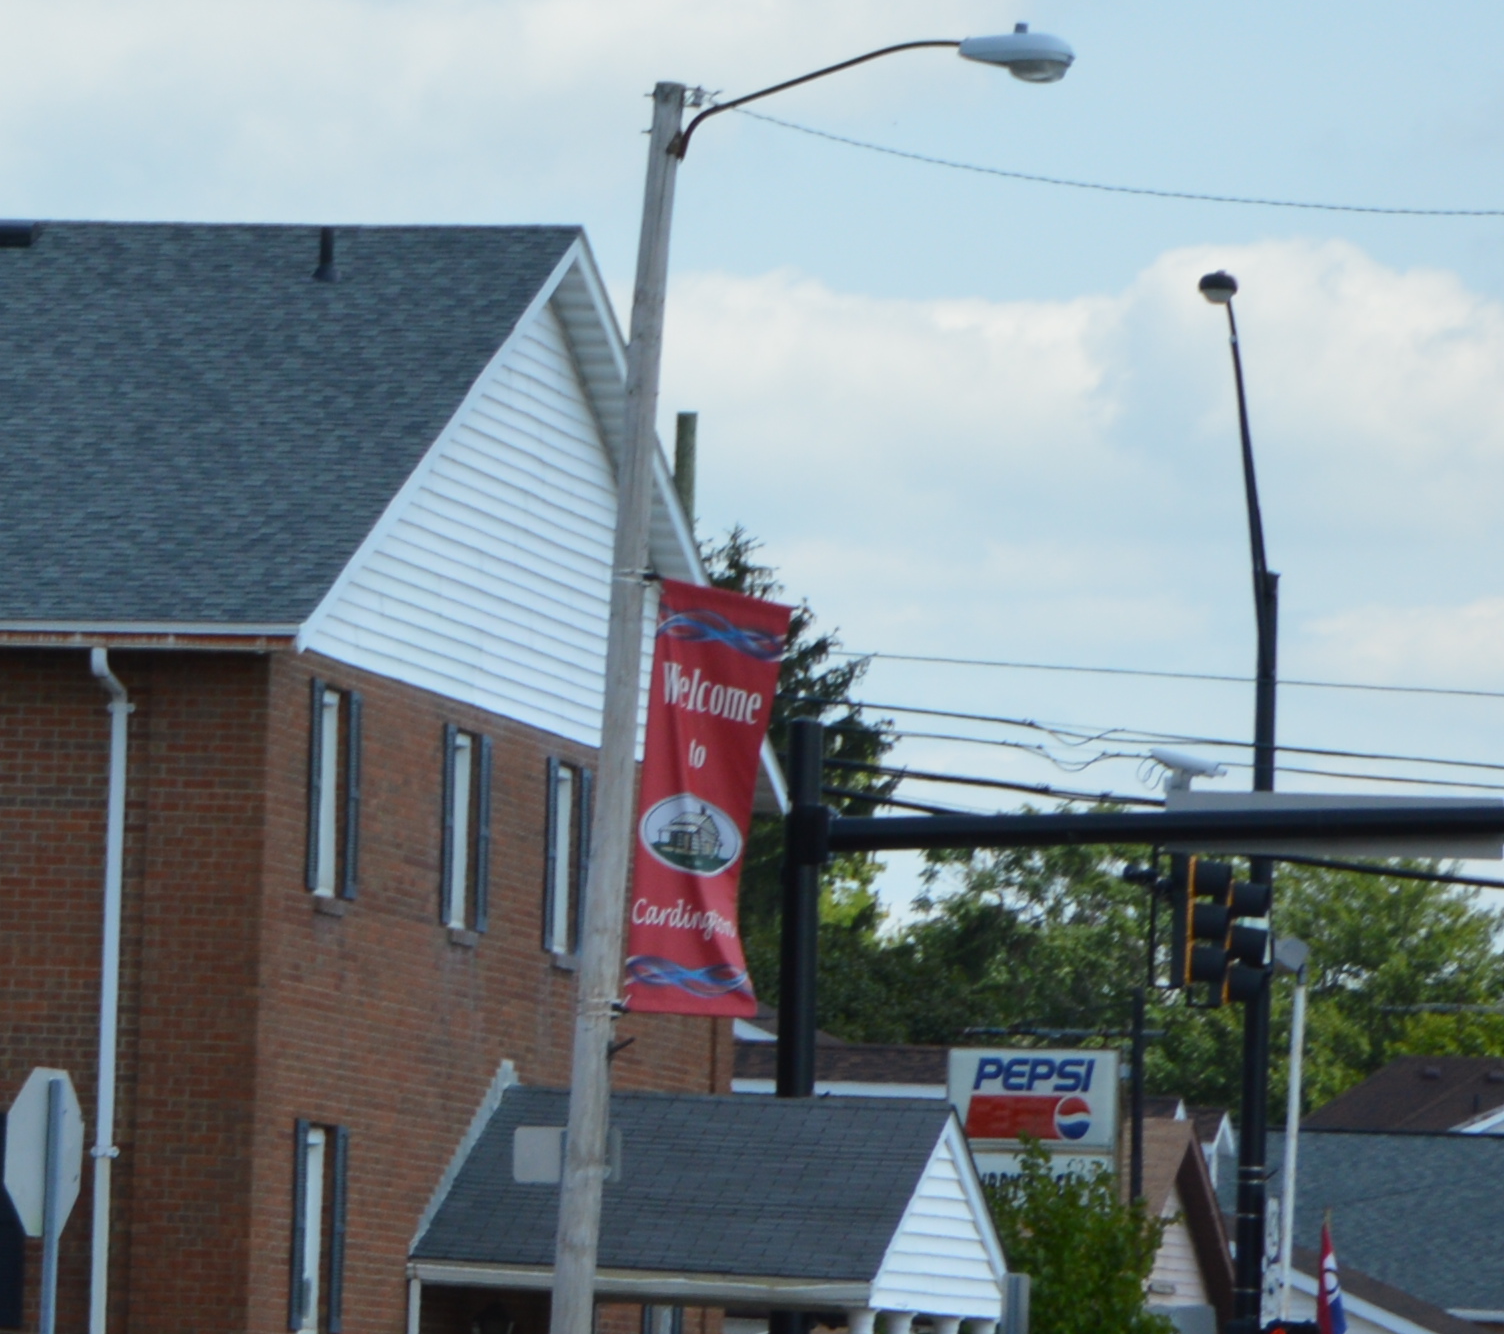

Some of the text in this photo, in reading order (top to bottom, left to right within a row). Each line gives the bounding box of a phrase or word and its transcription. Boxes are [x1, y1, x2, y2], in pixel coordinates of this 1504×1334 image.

[663, 661, 763, 725] Welcome
[688, 738, 706, 768] to
[973, 1057, 1095, 1092] PEPSI
